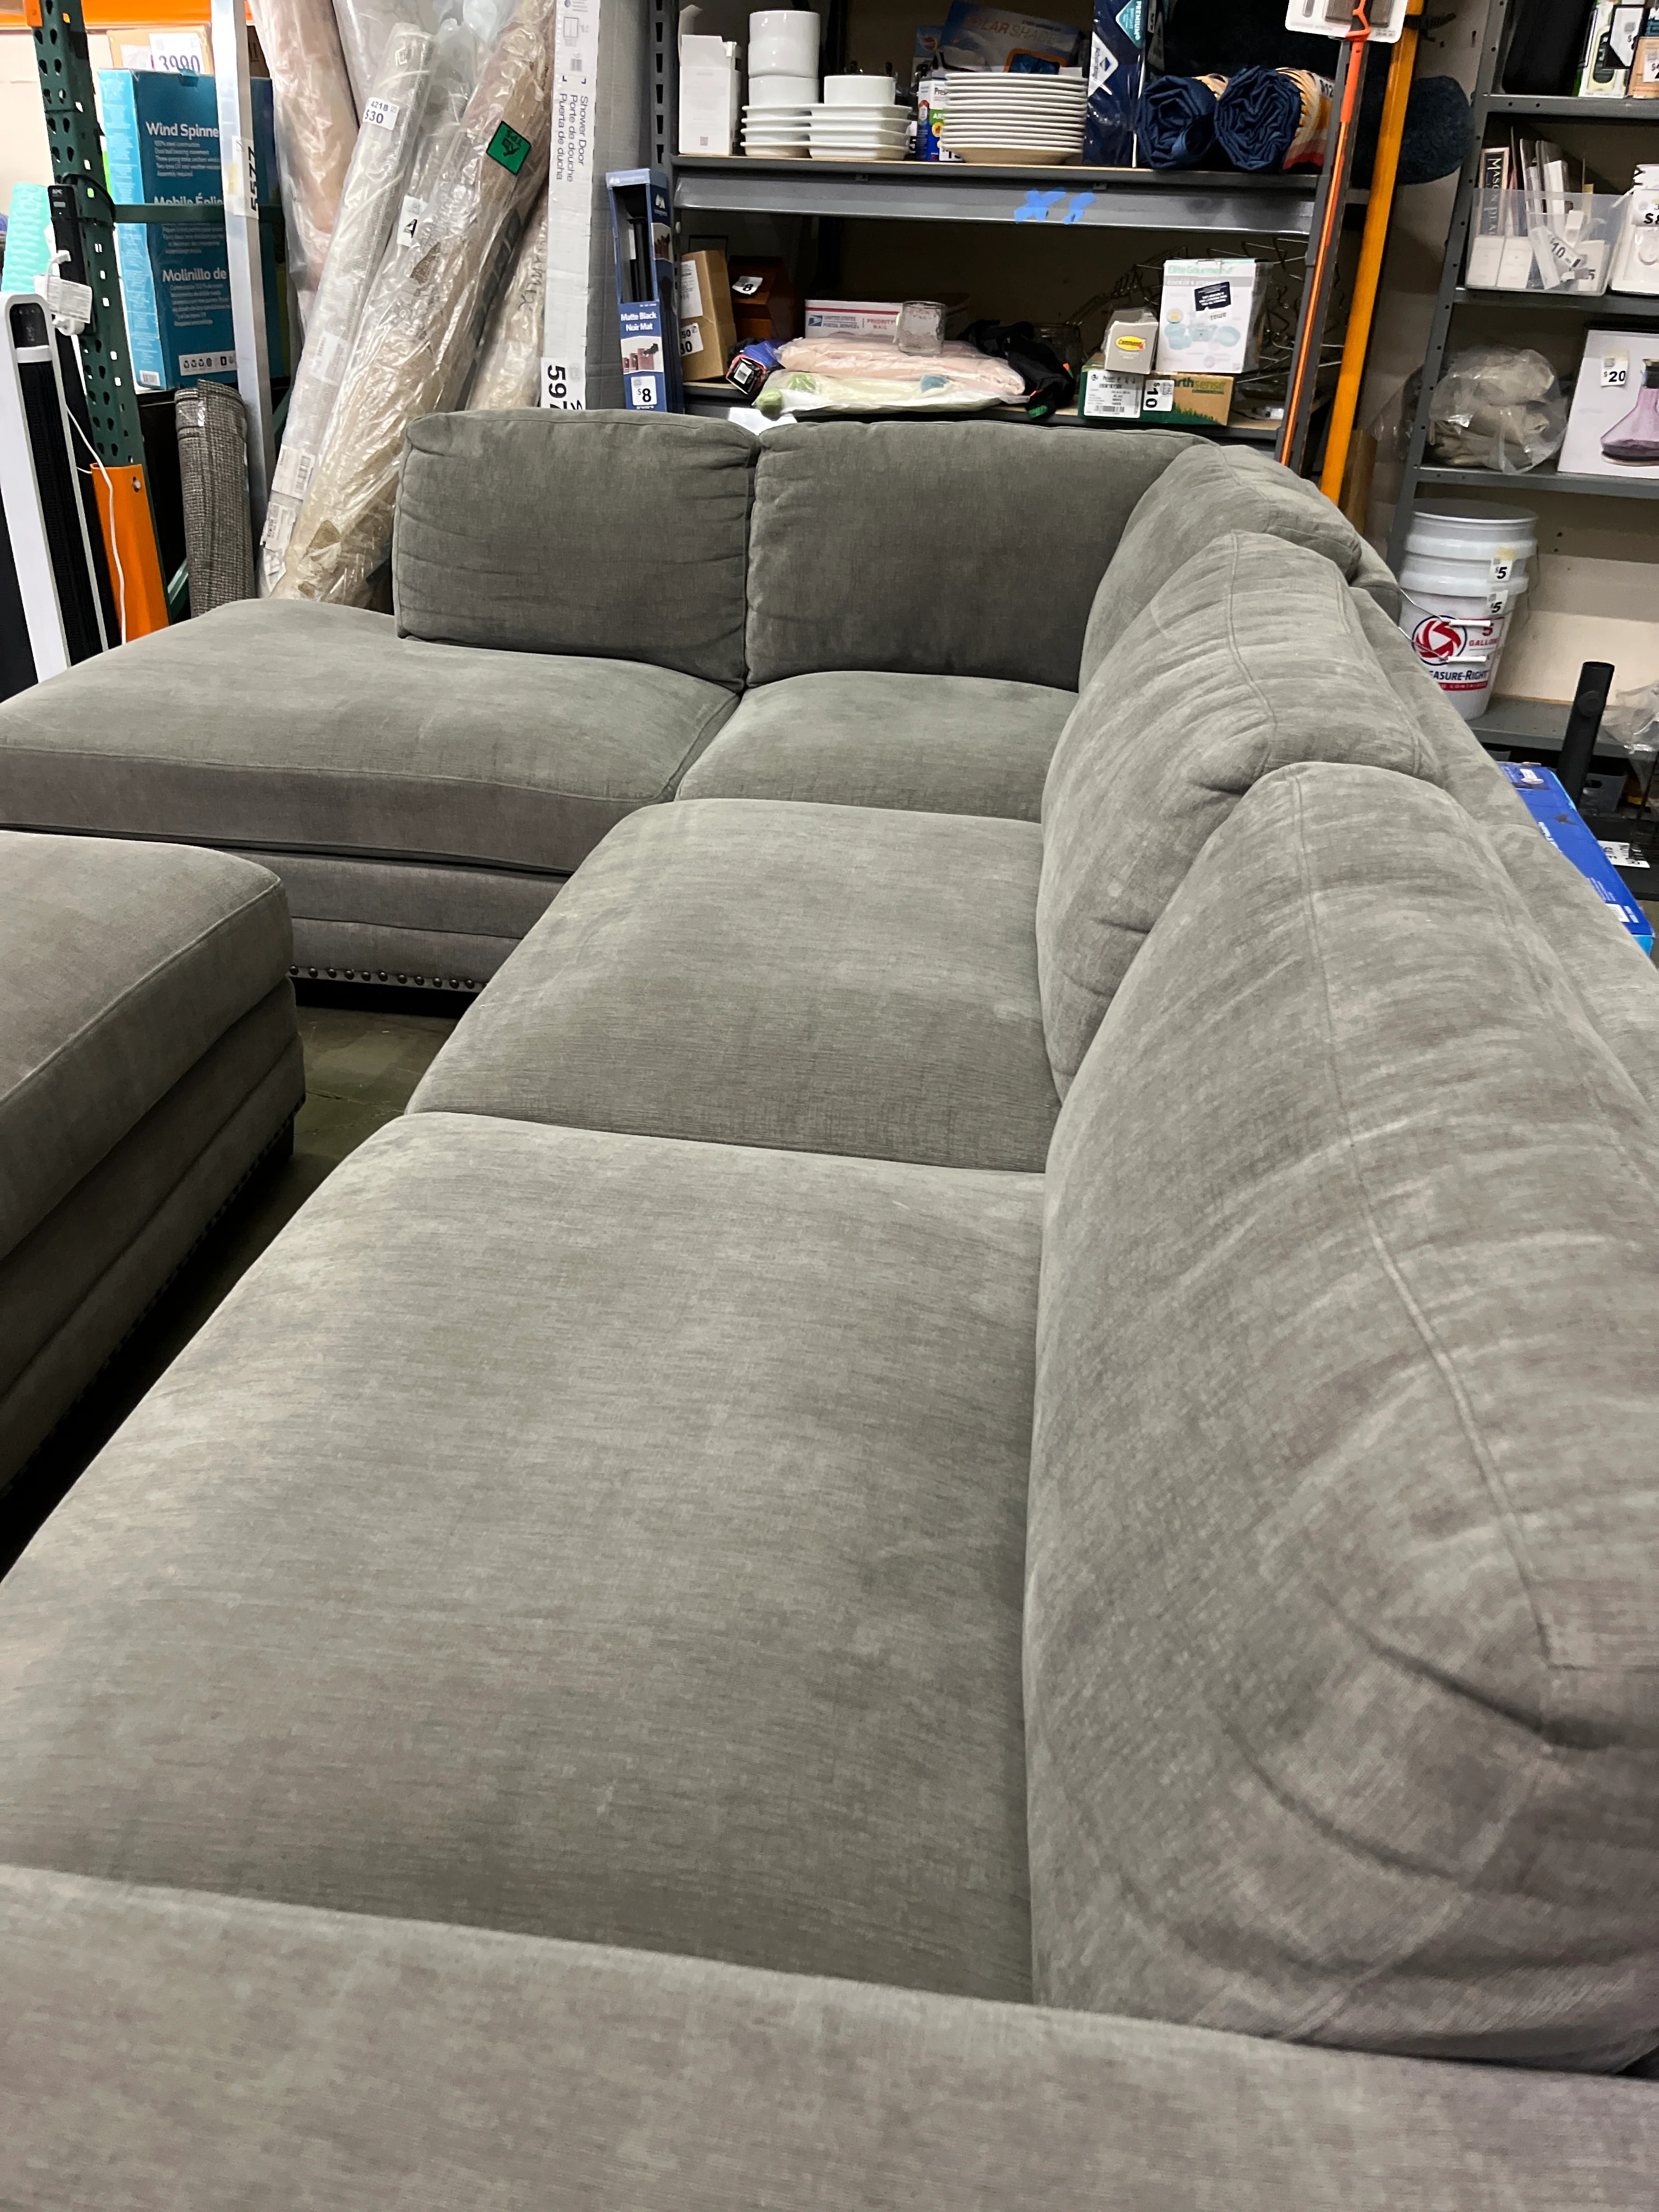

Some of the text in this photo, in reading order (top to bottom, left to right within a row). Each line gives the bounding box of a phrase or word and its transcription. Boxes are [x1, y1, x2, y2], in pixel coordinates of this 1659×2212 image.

[145, 121, 178, 136] Wind
[556, 93, 567, 179] Puerta de ducha
[578, 95, 588, 166] Shower Door
[567, 94, 578, 182] Porte de douche
[162, 267, 227, 282] Molinillo de
[620, 311, 657, 321] Matte Black
[625, 323, 640, 332] Noir
[1604, 370, 1626, 382] $20
[637, 388, 652, 403] $8
[1146, 382, 1160, 408] $10
